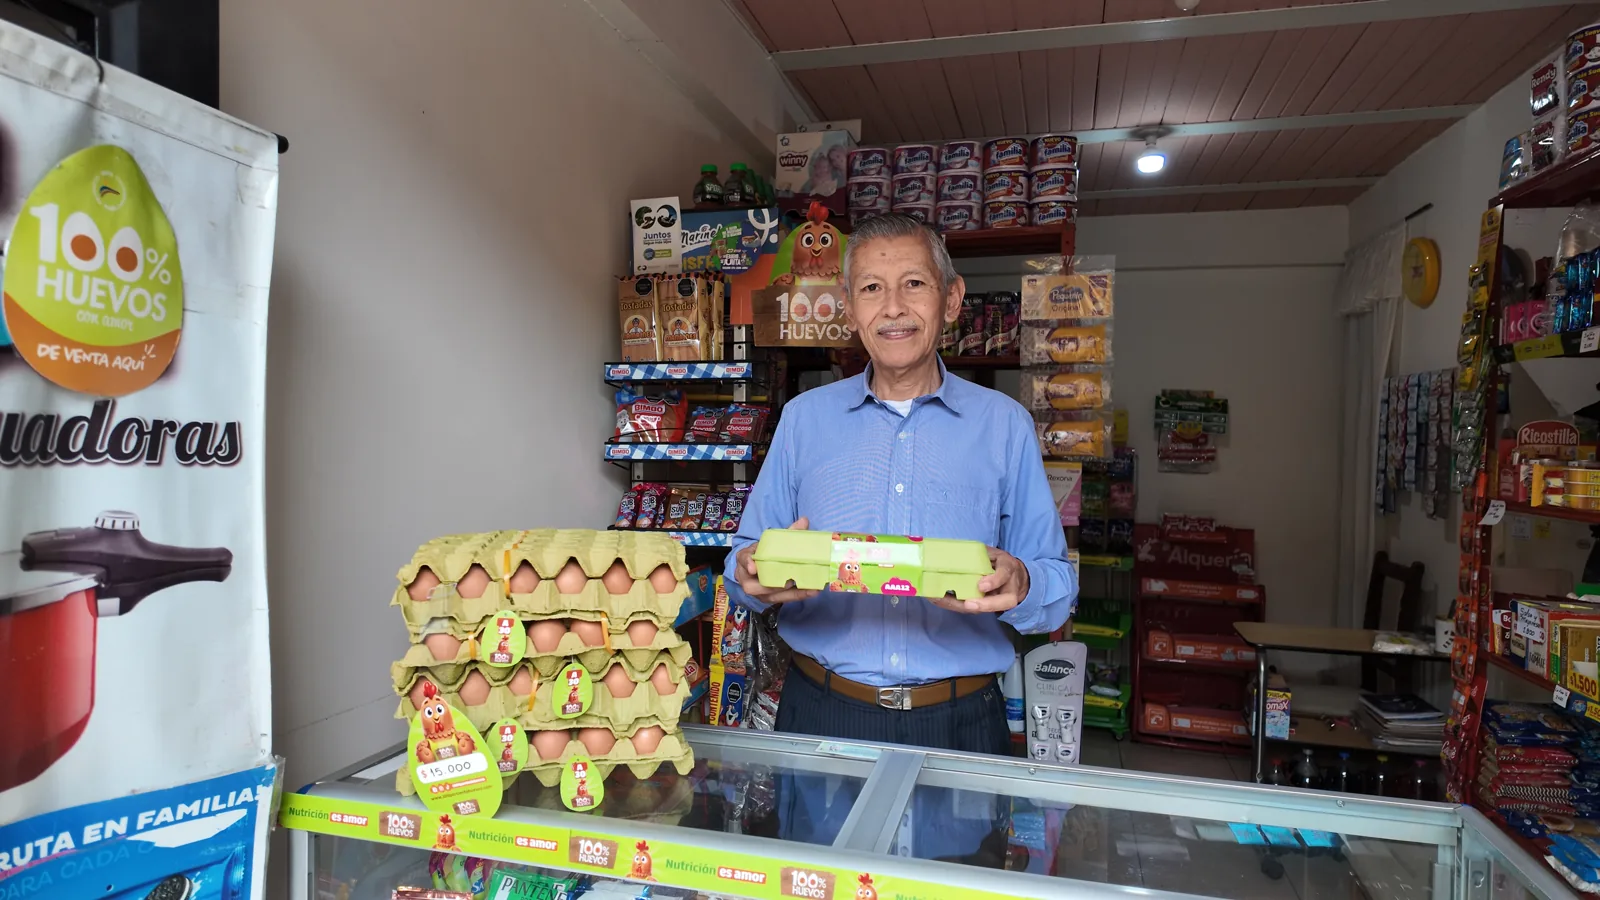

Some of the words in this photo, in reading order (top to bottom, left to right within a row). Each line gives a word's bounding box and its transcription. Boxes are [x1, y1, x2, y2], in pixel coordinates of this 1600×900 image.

[1531, 67, 1557, 89] Rendy
[945, 149, 970, 161] familia
[996, 146, 1022, 159] familia
[1044, 144, 1071, 156] familia
[780, 154, 808, 167] winny
[860, 156, 883, 167] familia
[905, 153, 929, 164] familia
[898, 183, 922, 194] familia
[948, 182, 973, 192] familia
[986, 178, 1011, 192] familia
[1037, 176, 1064, 189] familia
[854, 188, 878, 198] familia
[944, 214, 968, 222] familia
[990, 209, 1016, 220] familia
[1039, 208, 1066, 222] familia
[29, 202, 171, 285] 100%
[37, 265, 166, 322] HUEVOS
[621, 300, 653, 310] Tostadas
[663, 302, 696, 312] Tostadas
[76, 309, 99, 323] con
[102, 313, 134, 331] amor
[780, 323, 852, 341] HUEVOS
[37, 343, 59, 360] DE
[64, 347, 108, 368] VENTA
[667, 367, 687, 375] BIMBO
[634, 404, 663, 412] BIMBO
[0, 399, 242, 465] uadoras
[1521, 428, 1577, 444] Ricostilla
[621, 498, 634, 508] SUB
[642, 496, 656, 506] SUB
[688, 502, 702, 511] SUB
[727, 500, 742, 509] SUB
[671, 506, 684, 514] SUB
[706, 506, 720, 515] SUB
[714, 584, 728, 622] CONTENIDO
[502, 619, 509, 627] A
[712, 622, 723, 647] EXTRA
[1034, 664, 1076, 675] Balance
[1570, 672, 1597, 696] $1.500
[710, 682, 721, 722] CONTENIDO
[421, 770, 428, 778] $
[430, 762, 471, 777] 15.000
[574, 770, 586, 778] 30
[288, 806, 329, 820] Nutrición
[331, 812, 342, 822] es
[344, 813, 368, 826] amor
[387, 813, 415, 830] 100%
[388, 827, 414, 838] HUEVOS
[0, 831, 75, 873] RUTA
[82, 816, 128, 845] EN
[469, 830, 514, 845] Nutrición
[516, 836, 528, 846] es
[530, 838, 557, 850] amor
[579, 840, 610, 857] 100%
[60, 849, 130, 879] CADA
[579, 854, 608, 866] HUEVOS
[666, 858, 716, 876] Nutrición
[720, 867, 732, 878] es
[734, 869, 766, 884] amor
[791, 871, 826, 888] 100%
[501, 877, 568, 900] PANTENE
[792, 886, 825, 899] HUEVOS
